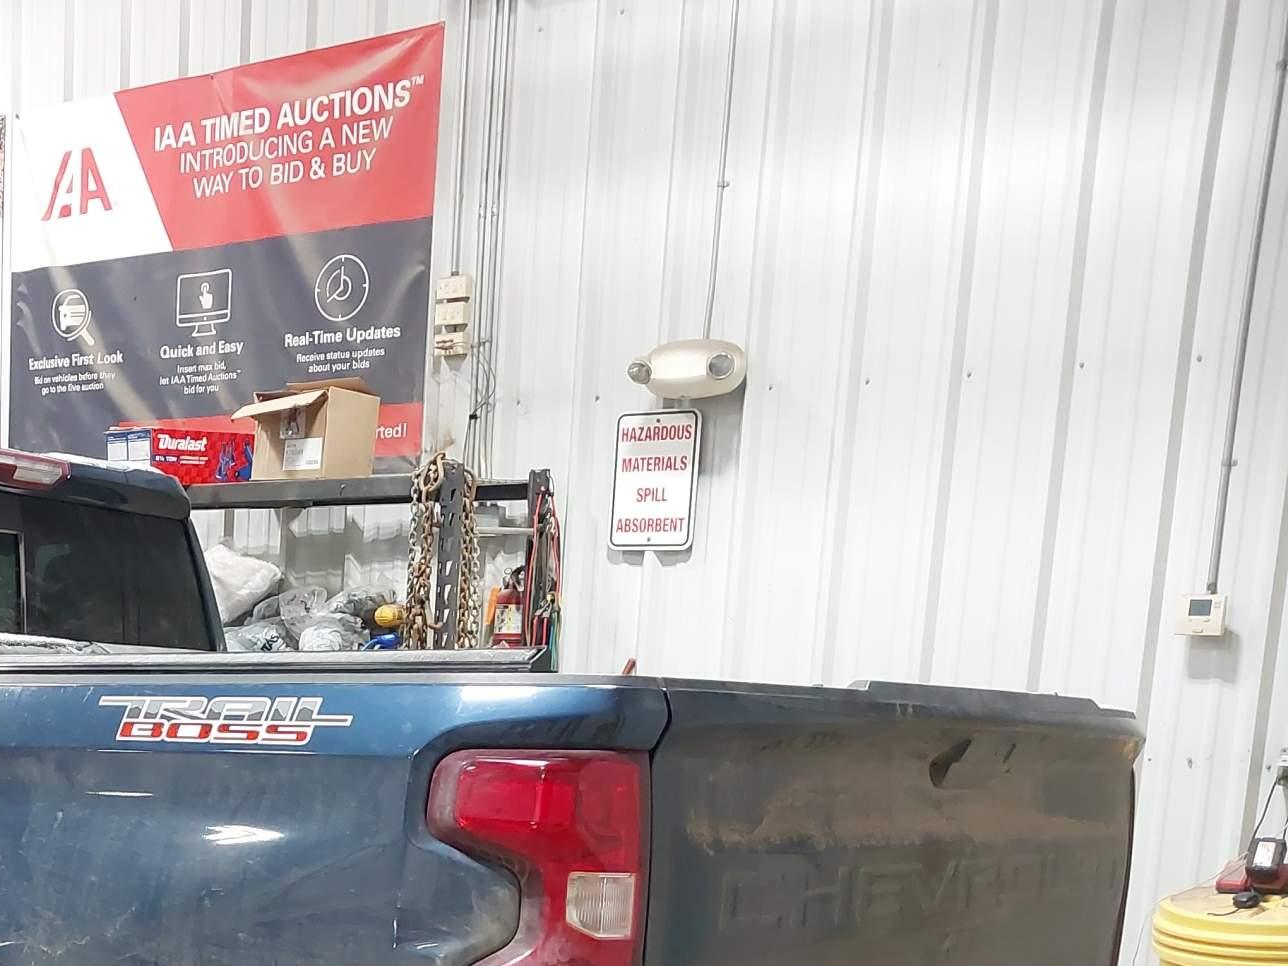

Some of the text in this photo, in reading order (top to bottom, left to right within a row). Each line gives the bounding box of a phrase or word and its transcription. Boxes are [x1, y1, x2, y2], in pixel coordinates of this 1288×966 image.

[154, 121, 196, 151] IAA
[200, 107, 270, 144] TIMED
[180, 116, 394, 173] INTRODUCING A NEW
[192, 148, 376, 198] WAY TO BID & BUY
[284, 326, 401, 347] Real-Time Updates
[160, 340, 244, 359] Quick and Easy
[296, 348, 385, 363] Receive status updates
[29, 350, 123, 370] Exclusive First Look
[177, 364, 197, 373] Insert
[308, 359, 370, 373] about your bids
[171, 375, 185, 384] IAA
[187, 374, 207, 383] Timed
[183, 384, 219, 395] bid for you
[375, 423, 408, 439] rted!
[621, 424, 693, 442] HAZARDOUS
[157, 433, 208, 452] Duralast
[621, 455, 688, 472] MATERIALS
[636, 487, 668, 503] SPILL
[616, 517, 686, 533] ABSORBENT
[99, 696, 354, 727] TRAIL
[116, 720, 315, 746] BOSS
